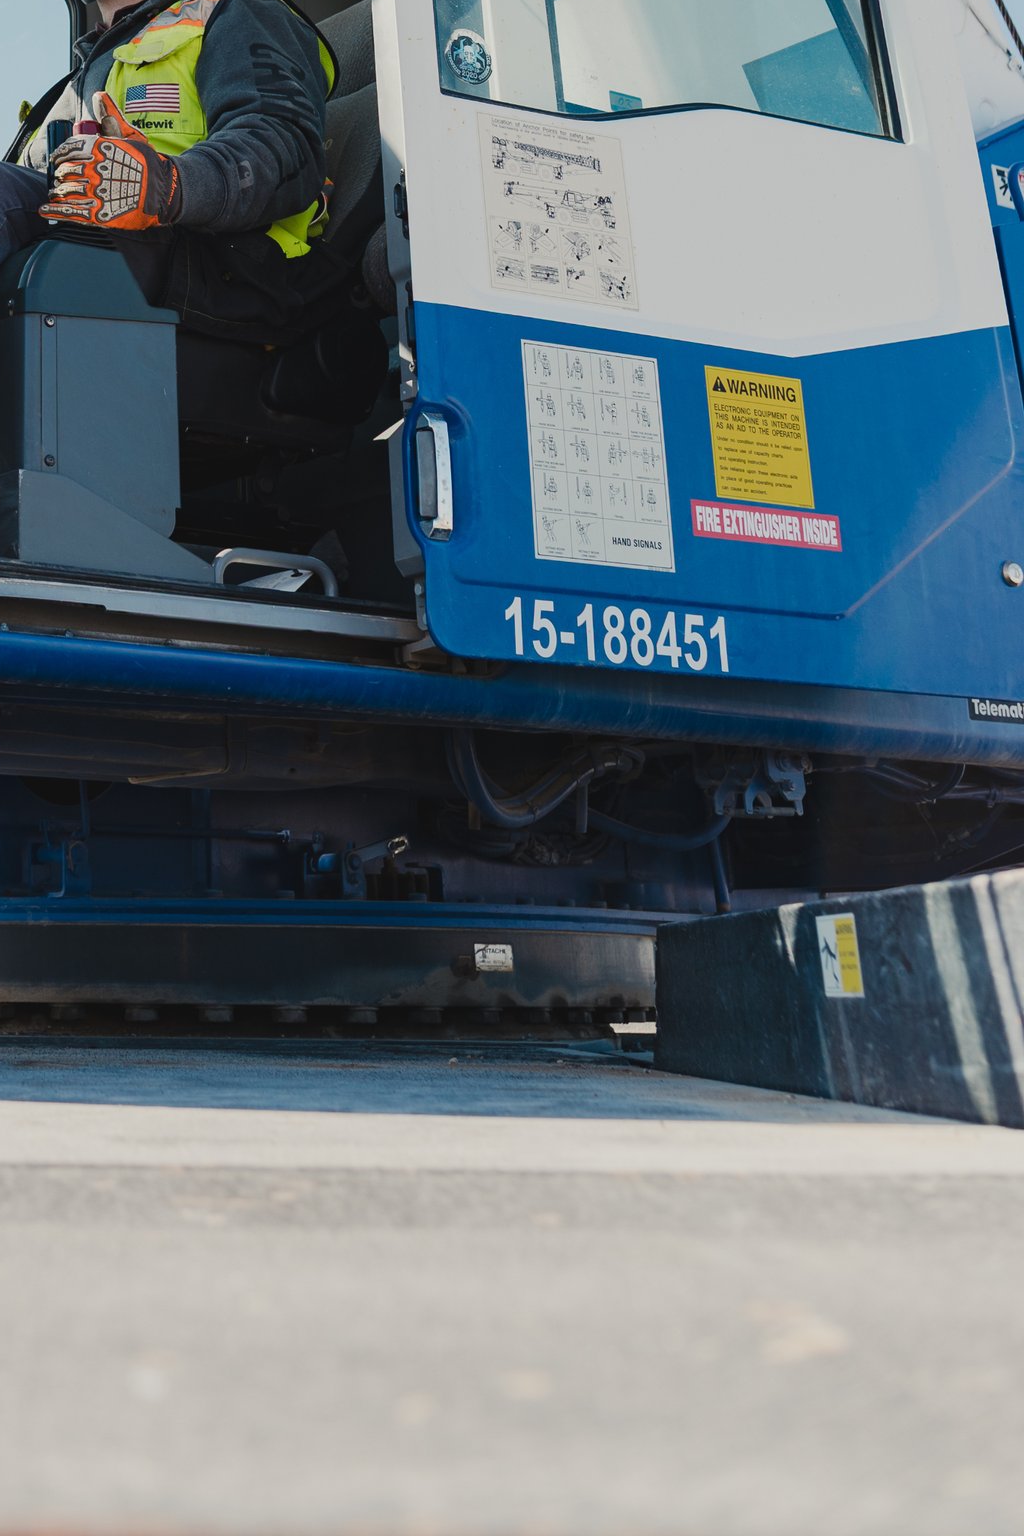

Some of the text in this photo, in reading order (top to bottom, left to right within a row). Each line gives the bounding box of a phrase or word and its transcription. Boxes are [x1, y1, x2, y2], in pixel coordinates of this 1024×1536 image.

[461, 70, 478, 79] 2020
[714, 403, 800, 422] ELECTRONIC EQUIPMENT ON
[715, 412, 729, 421] THIS
[732, 415, 759, 426] MACHINE
[771, 421, 801, 432] INTENDED
[737, 425, 747, 433] AID
[749, 426, 757, 434] TO
[759, 427, 770, 436] THE
[772, 429, 802, 440] OPERATOR
[695, 505, 839, 546] FIRE EXTINGUISHER INSIDE
[612, 536, 663, 550] HAND SIGNALS
[504, 596, 730, 673] 15-188451
